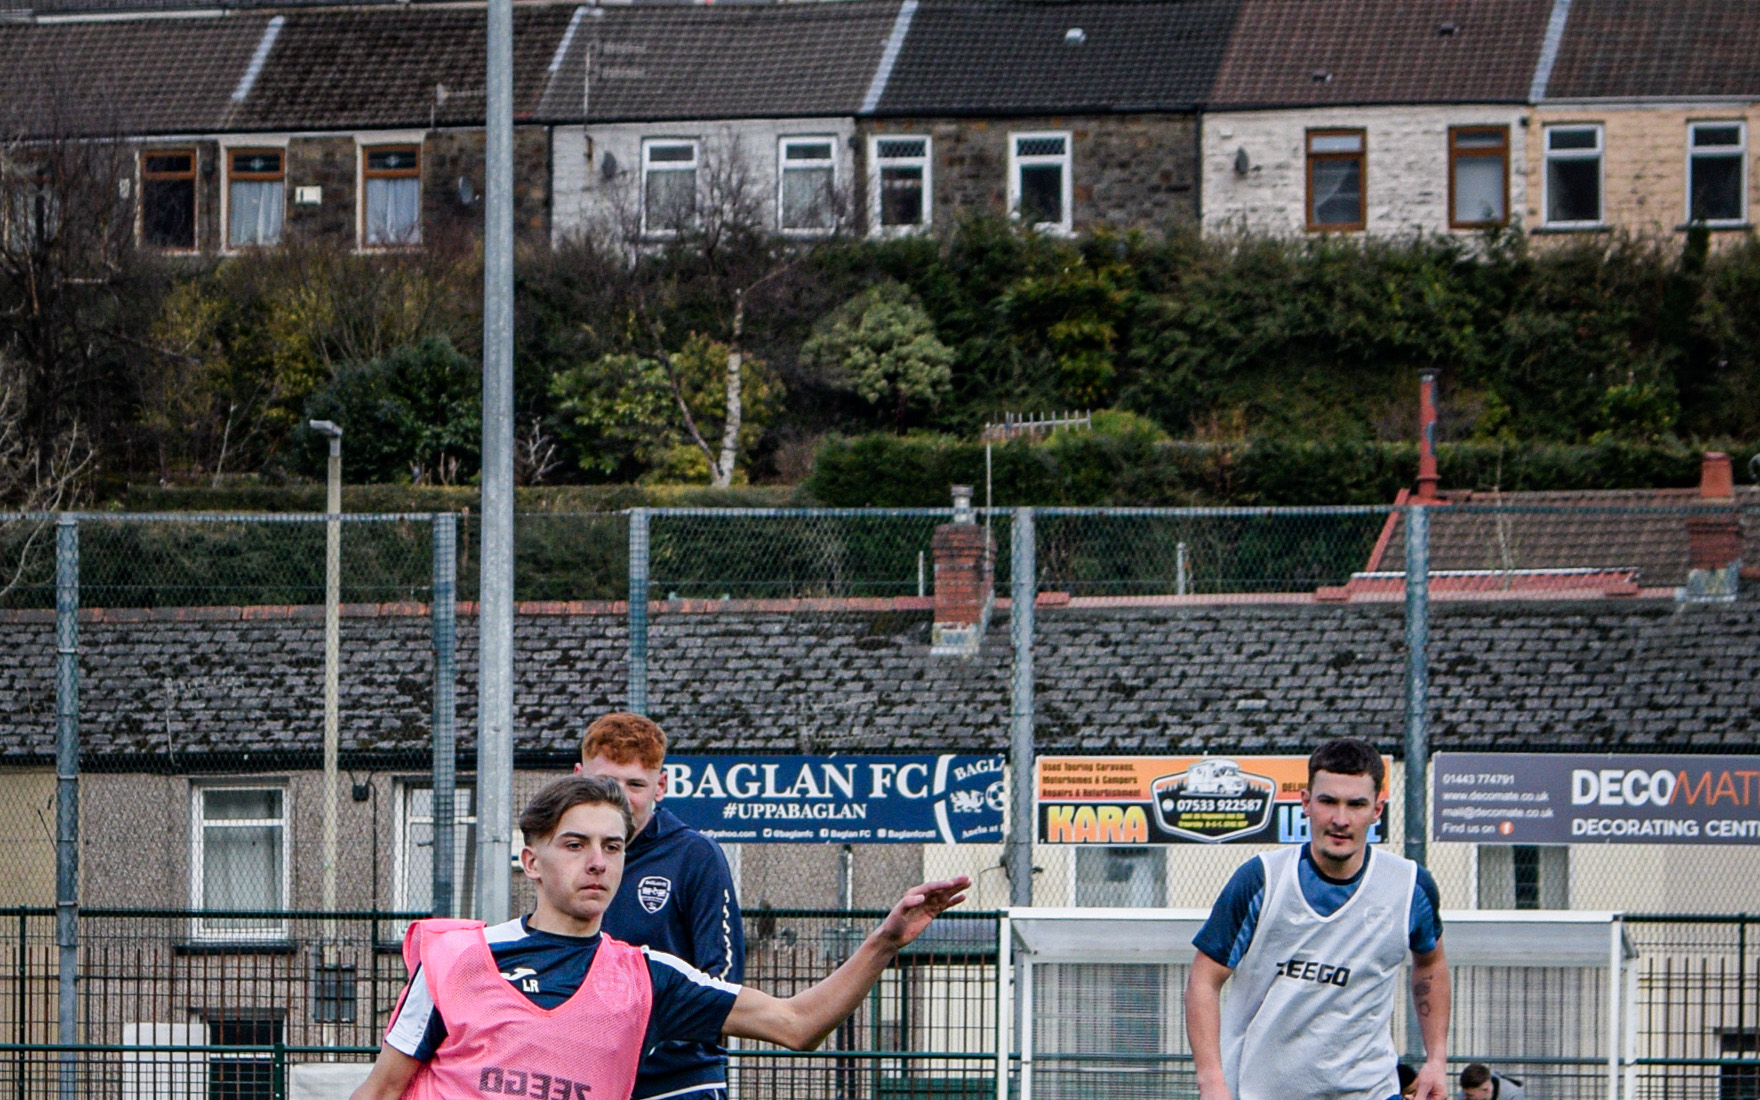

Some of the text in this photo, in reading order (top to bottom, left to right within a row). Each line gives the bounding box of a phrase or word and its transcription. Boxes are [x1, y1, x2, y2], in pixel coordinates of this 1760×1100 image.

[663, 763, 928, 799] BAGLAN FC
[1571, 768, 1760, 806] DECOMAT
[722, 802, 867, 819] #UPPABAGLAN
[1177, 799, 1215, 812] 07533
[1048, 805, 1149, 843] KARA
[1441, 822, 1465, 834] Find
[1466, 825, 1480, 834] us
[1481, 825, 1496, 834] on
[1571, 818, 1760, 837] DECORATING CENT
[859, 829, 871, 838] FC
[522, 979, 540, 993] LR
